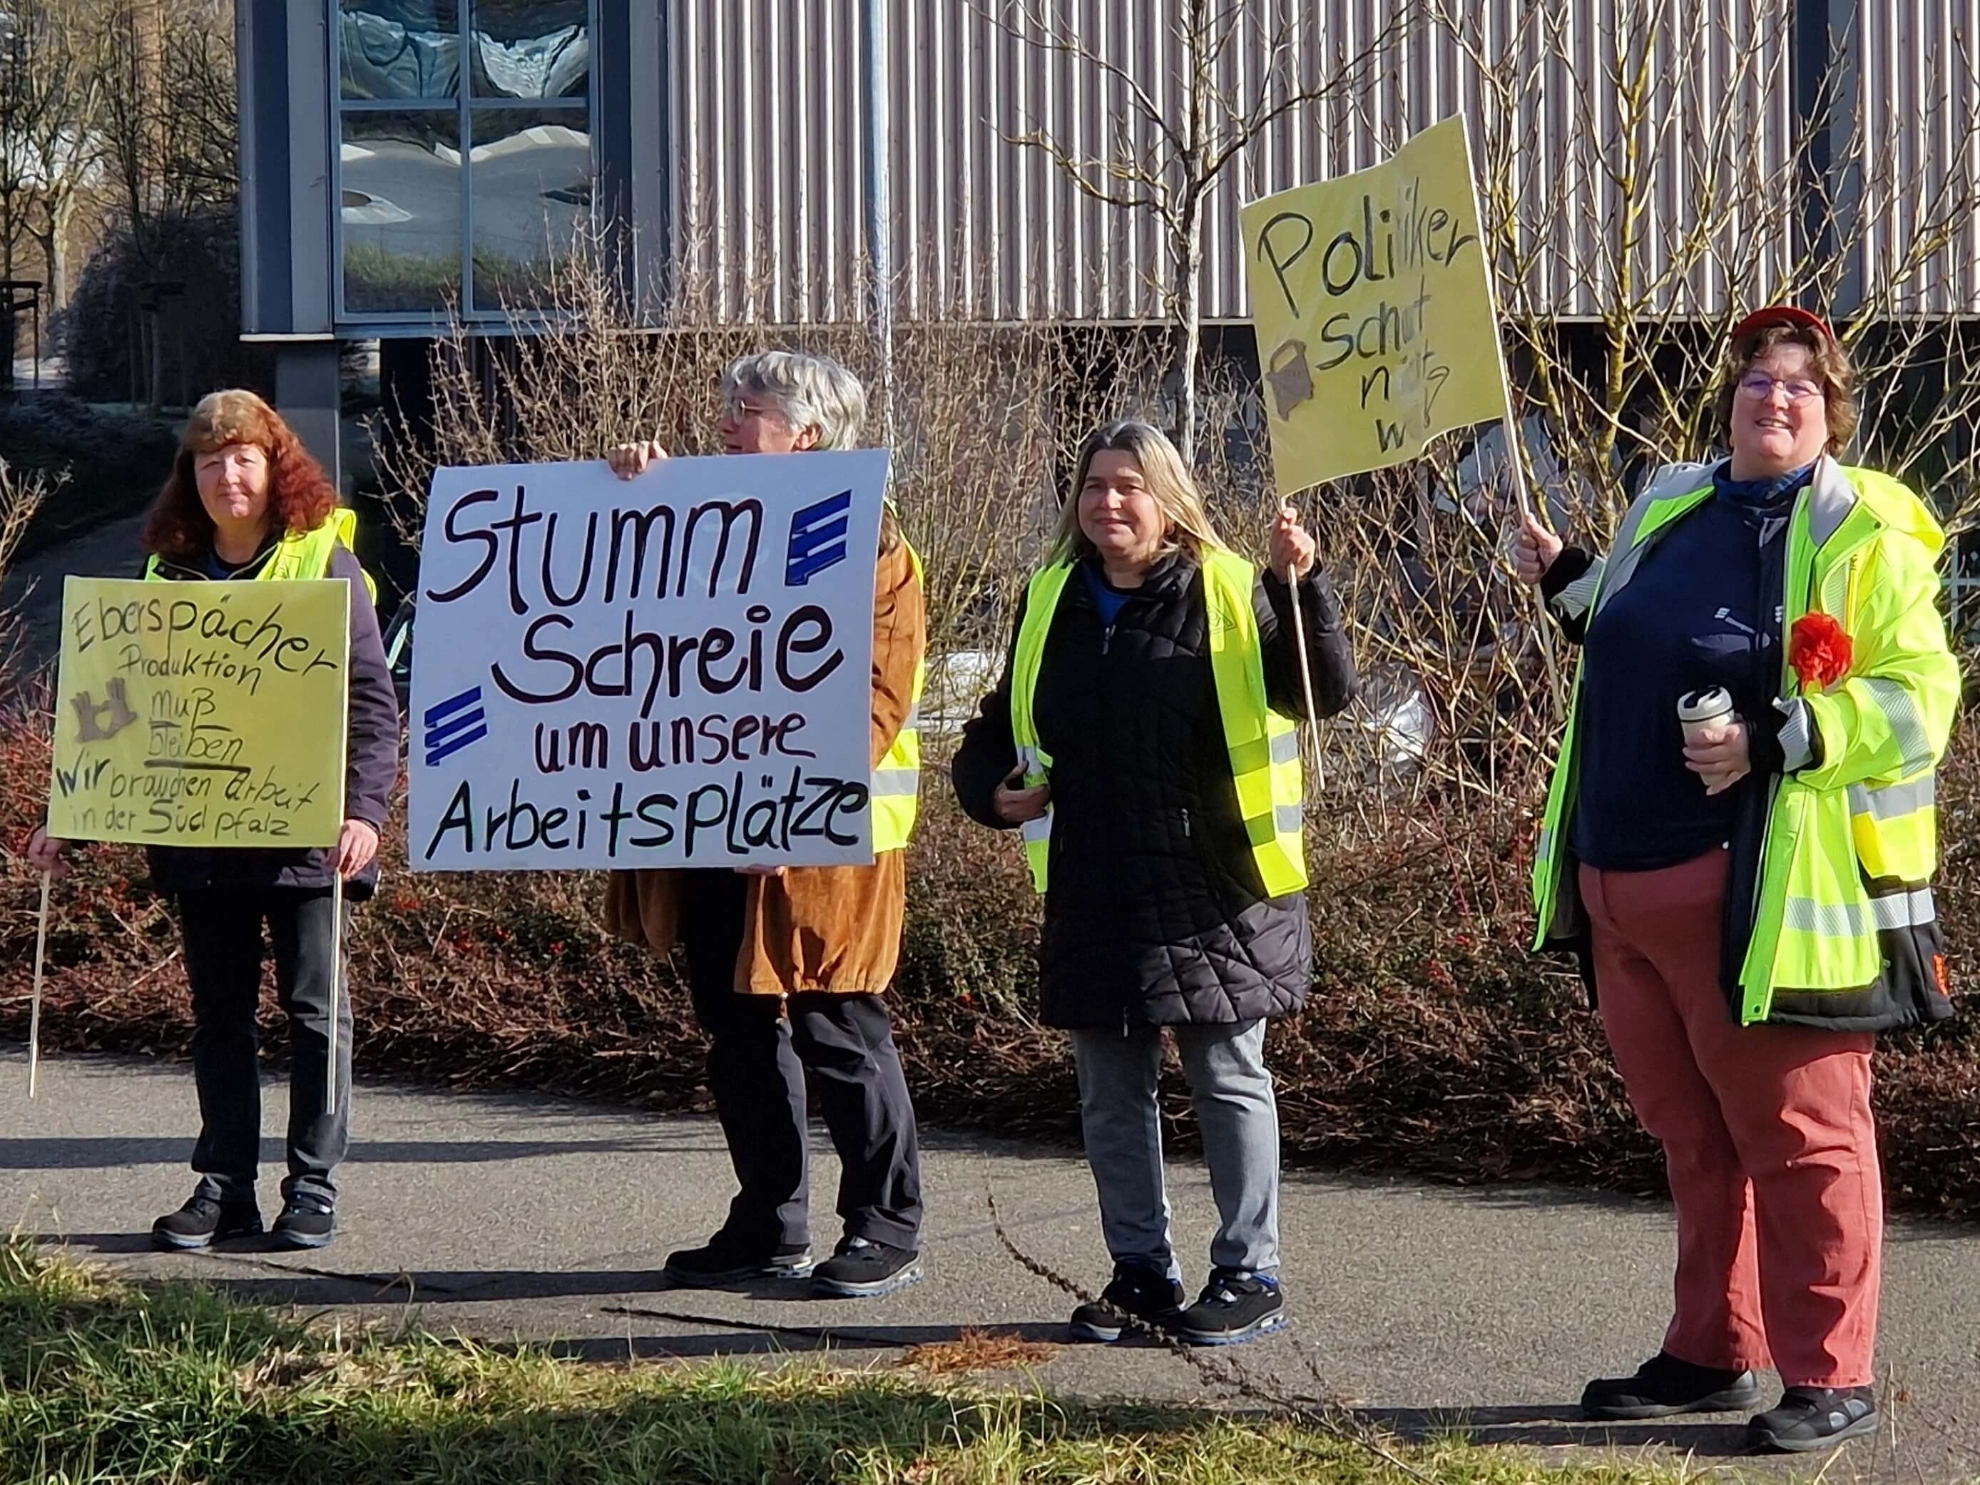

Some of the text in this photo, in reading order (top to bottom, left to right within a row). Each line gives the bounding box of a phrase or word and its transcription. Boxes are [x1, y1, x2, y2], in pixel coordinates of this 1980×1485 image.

[1257, 176, 1479, 319] Poliiker
[425, 485, 764, 615] Stumm
[71, 594, 338, 676] Eberspächer
[490, 604, 845, 718] Schreie
[117, 643, 263, 696] Produktion
[147, 725, 244, 764] bleiben
[533, 712, 816, 774] um unsere
[110, 765, 212, 799] brauchen
[69, 806, 96, 831] in
[104, 803, 137, 833] der
[141, 799, 206, 834] Süd
